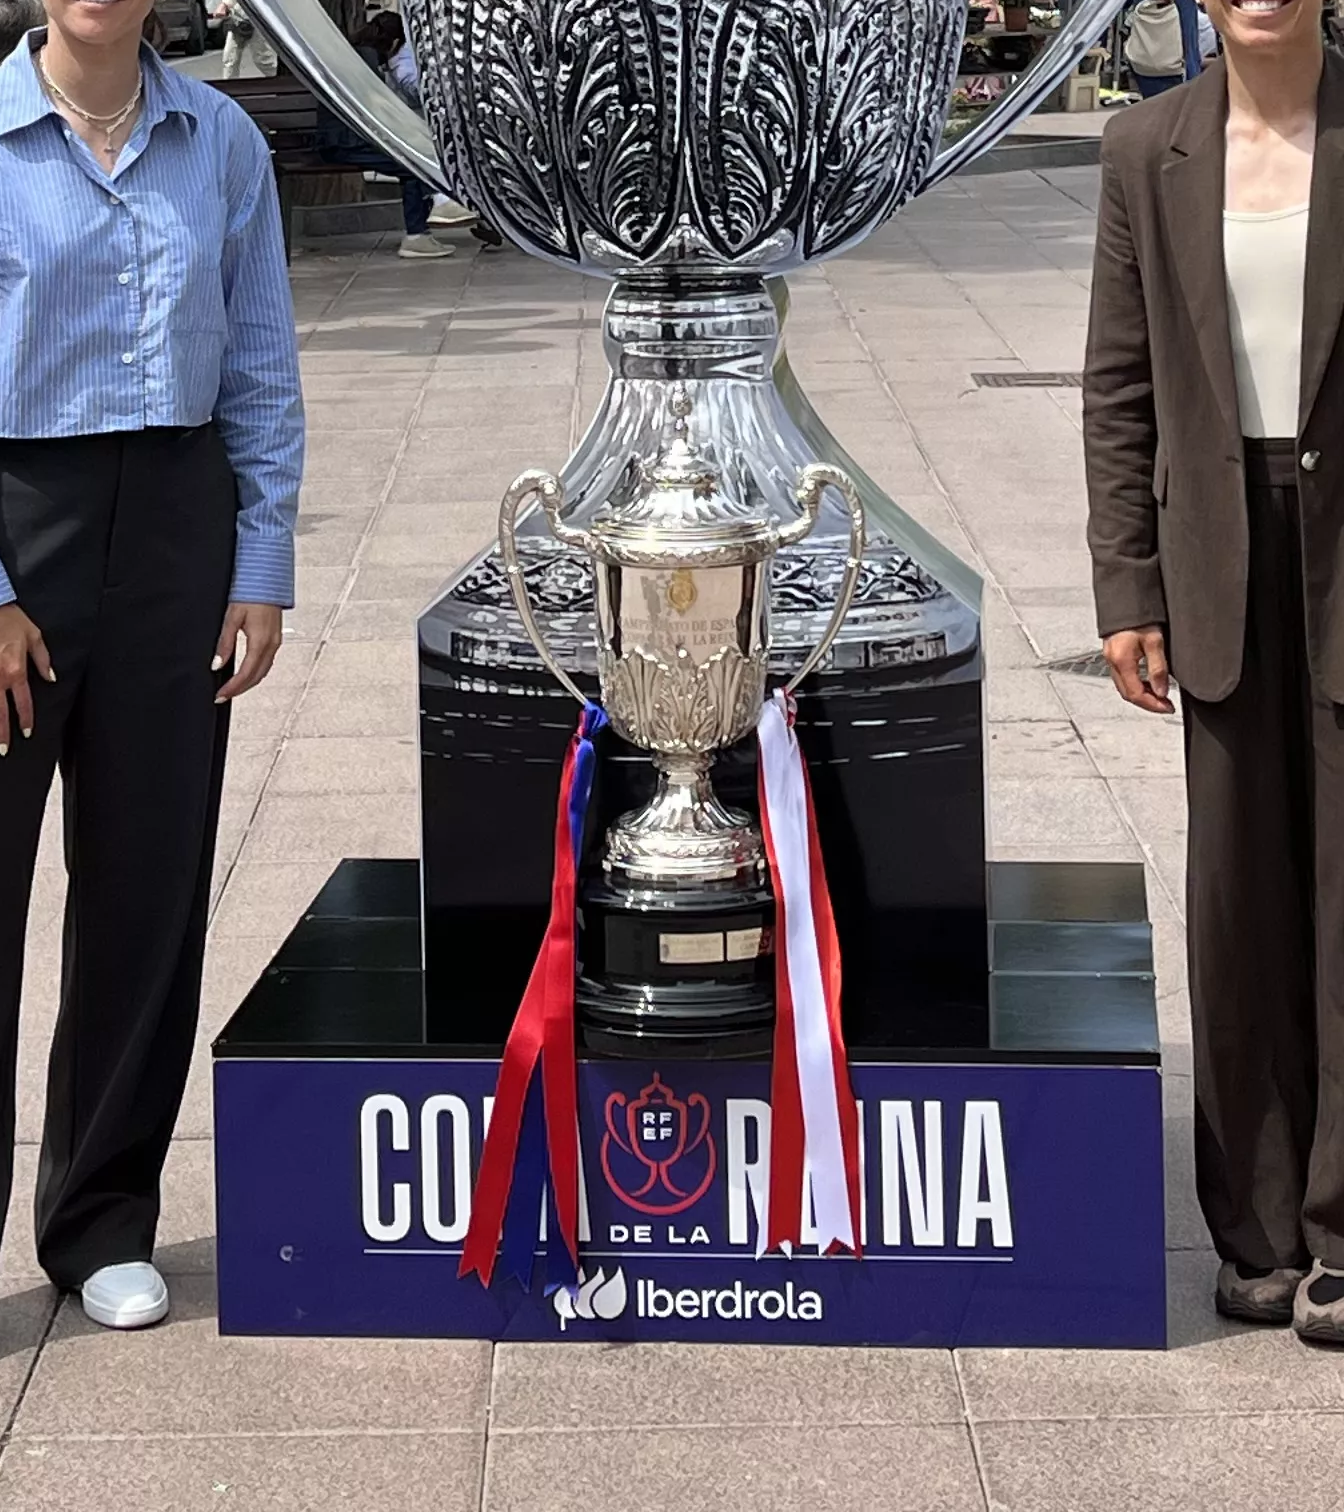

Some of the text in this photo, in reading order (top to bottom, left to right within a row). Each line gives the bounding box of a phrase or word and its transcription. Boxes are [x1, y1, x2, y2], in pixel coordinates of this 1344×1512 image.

[360, 1093, 1014, 1248] CO RNA
[609, 1224, 711, 1245] DE LA
[636, 1278, 823, 1320] Iberdrola
